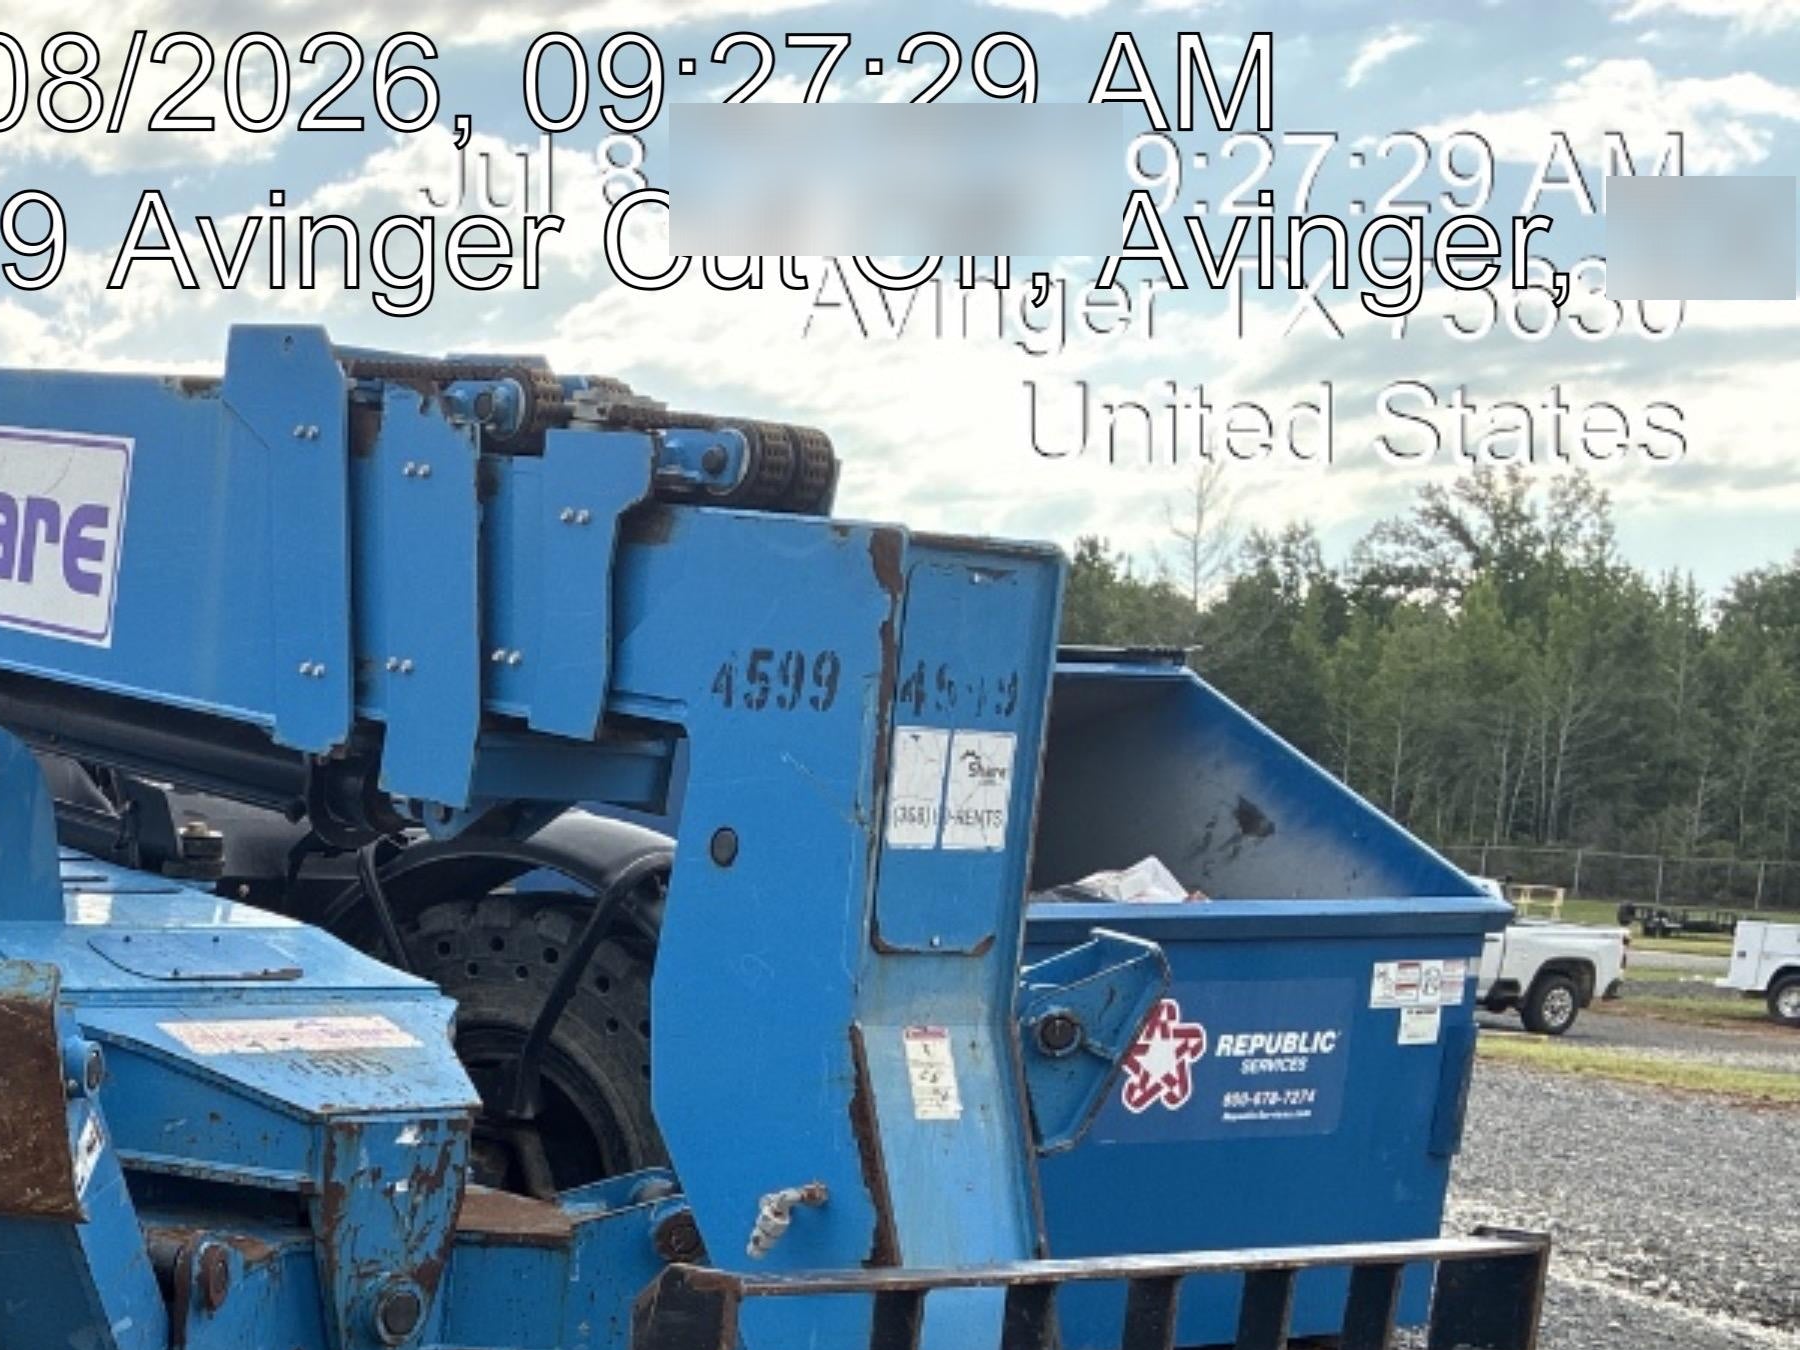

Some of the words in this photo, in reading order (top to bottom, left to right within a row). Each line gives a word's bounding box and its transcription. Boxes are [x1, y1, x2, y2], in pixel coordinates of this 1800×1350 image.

[711, 648, 841, 712] 4599
[1215, 1029, 1337, 1057] REPUBLIC
[1240, 1057, 1309, 1075] SERVICES
